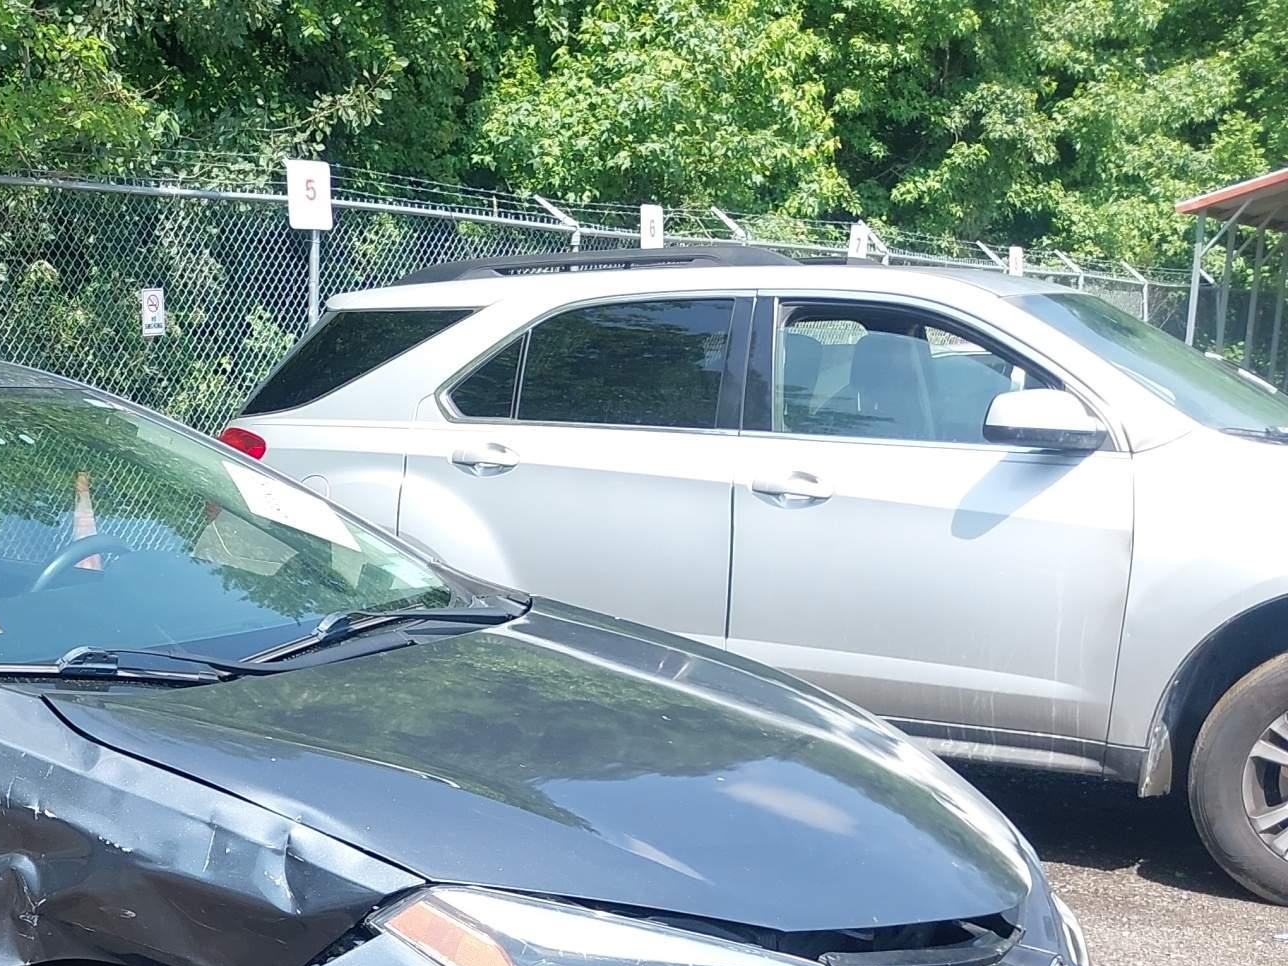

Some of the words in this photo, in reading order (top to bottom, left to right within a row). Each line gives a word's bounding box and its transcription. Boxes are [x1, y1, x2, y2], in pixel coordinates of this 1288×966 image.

[305, 179, 317, 201] 5
[649, 219, 656, 238] 6
[856, 237, 862, 253] 7
